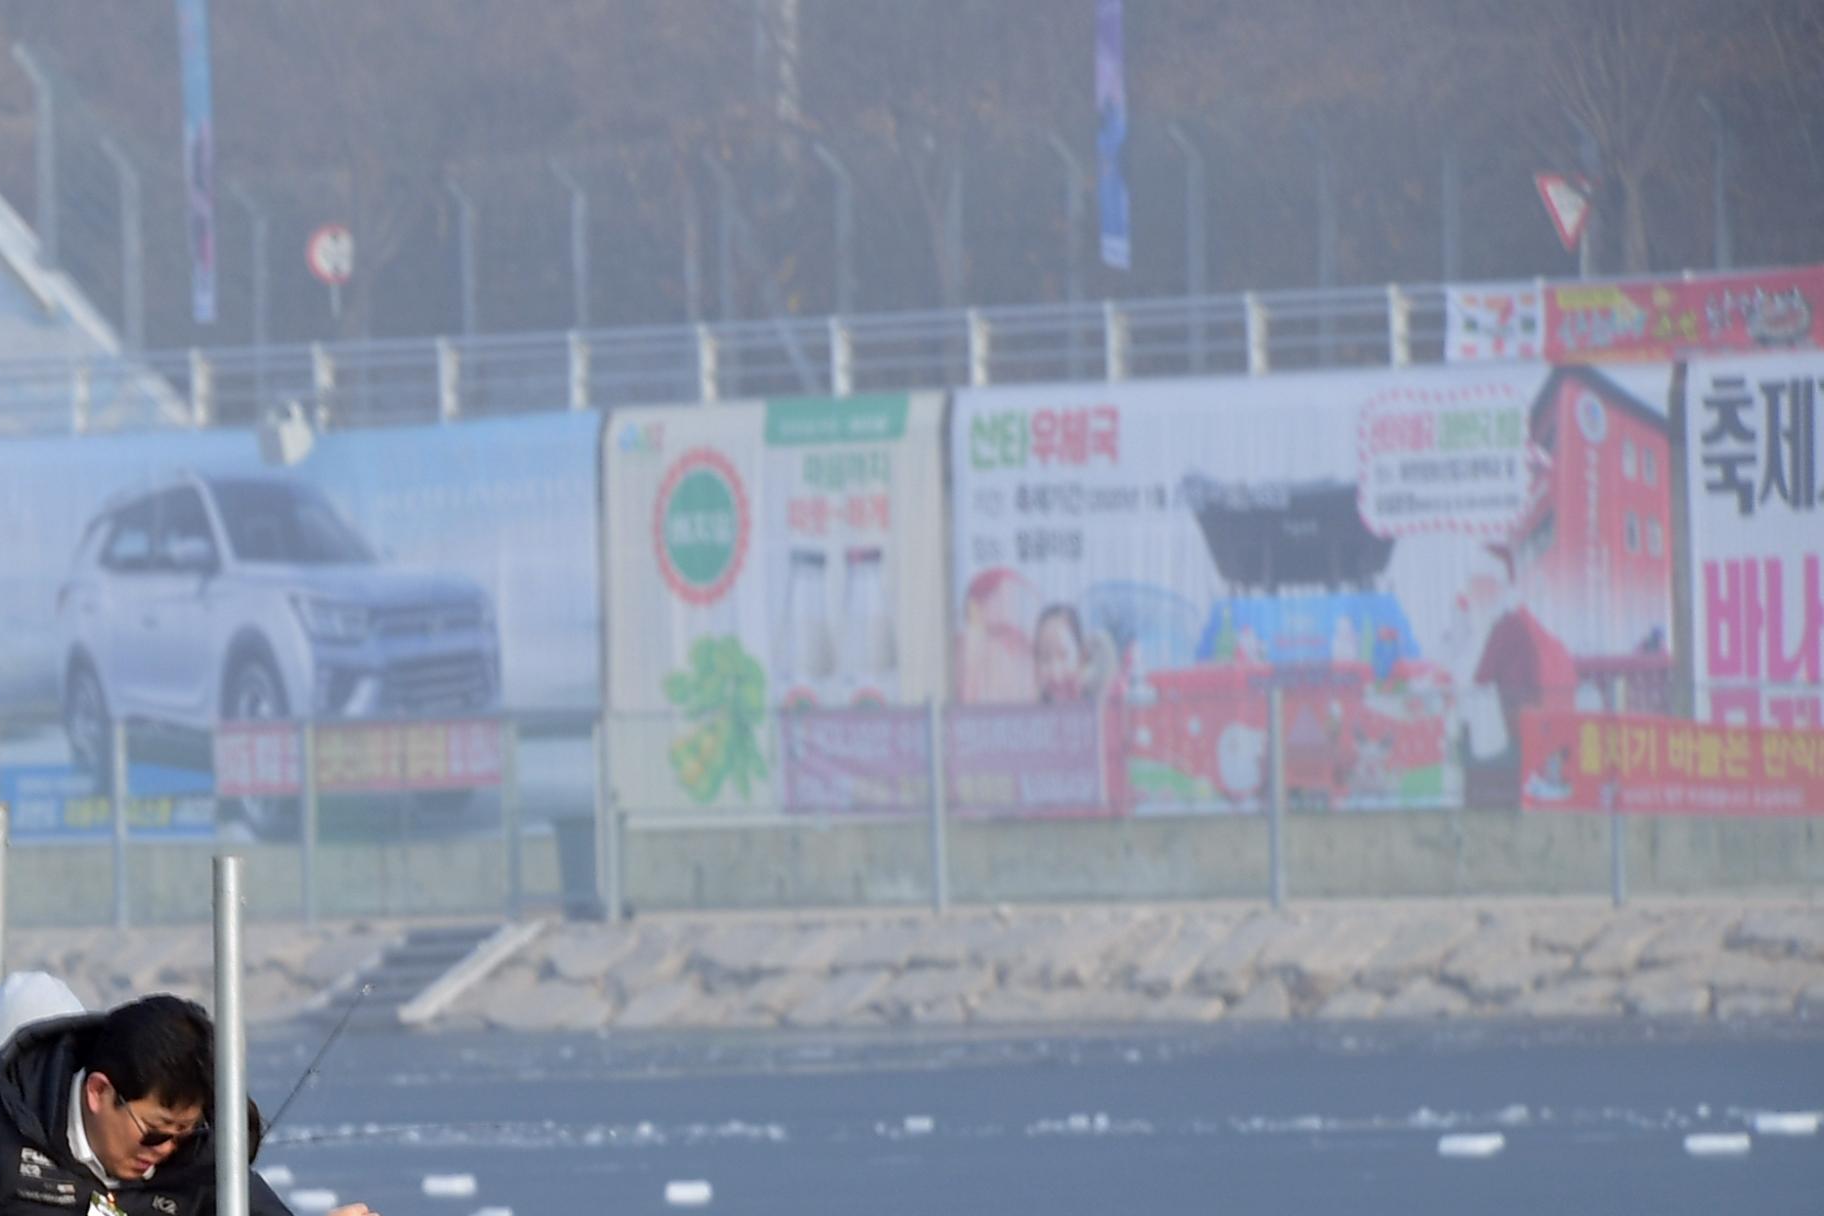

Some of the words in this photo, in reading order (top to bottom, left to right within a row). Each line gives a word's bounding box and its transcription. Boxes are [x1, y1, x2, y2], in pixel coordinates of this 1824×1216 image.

[1701, 376, 1824, 517] 축제
[1579, 721, 1658, 778] 치기
[1667, 726, 1752, 779] 바은
[152, 1195, 179, 1215] K2
